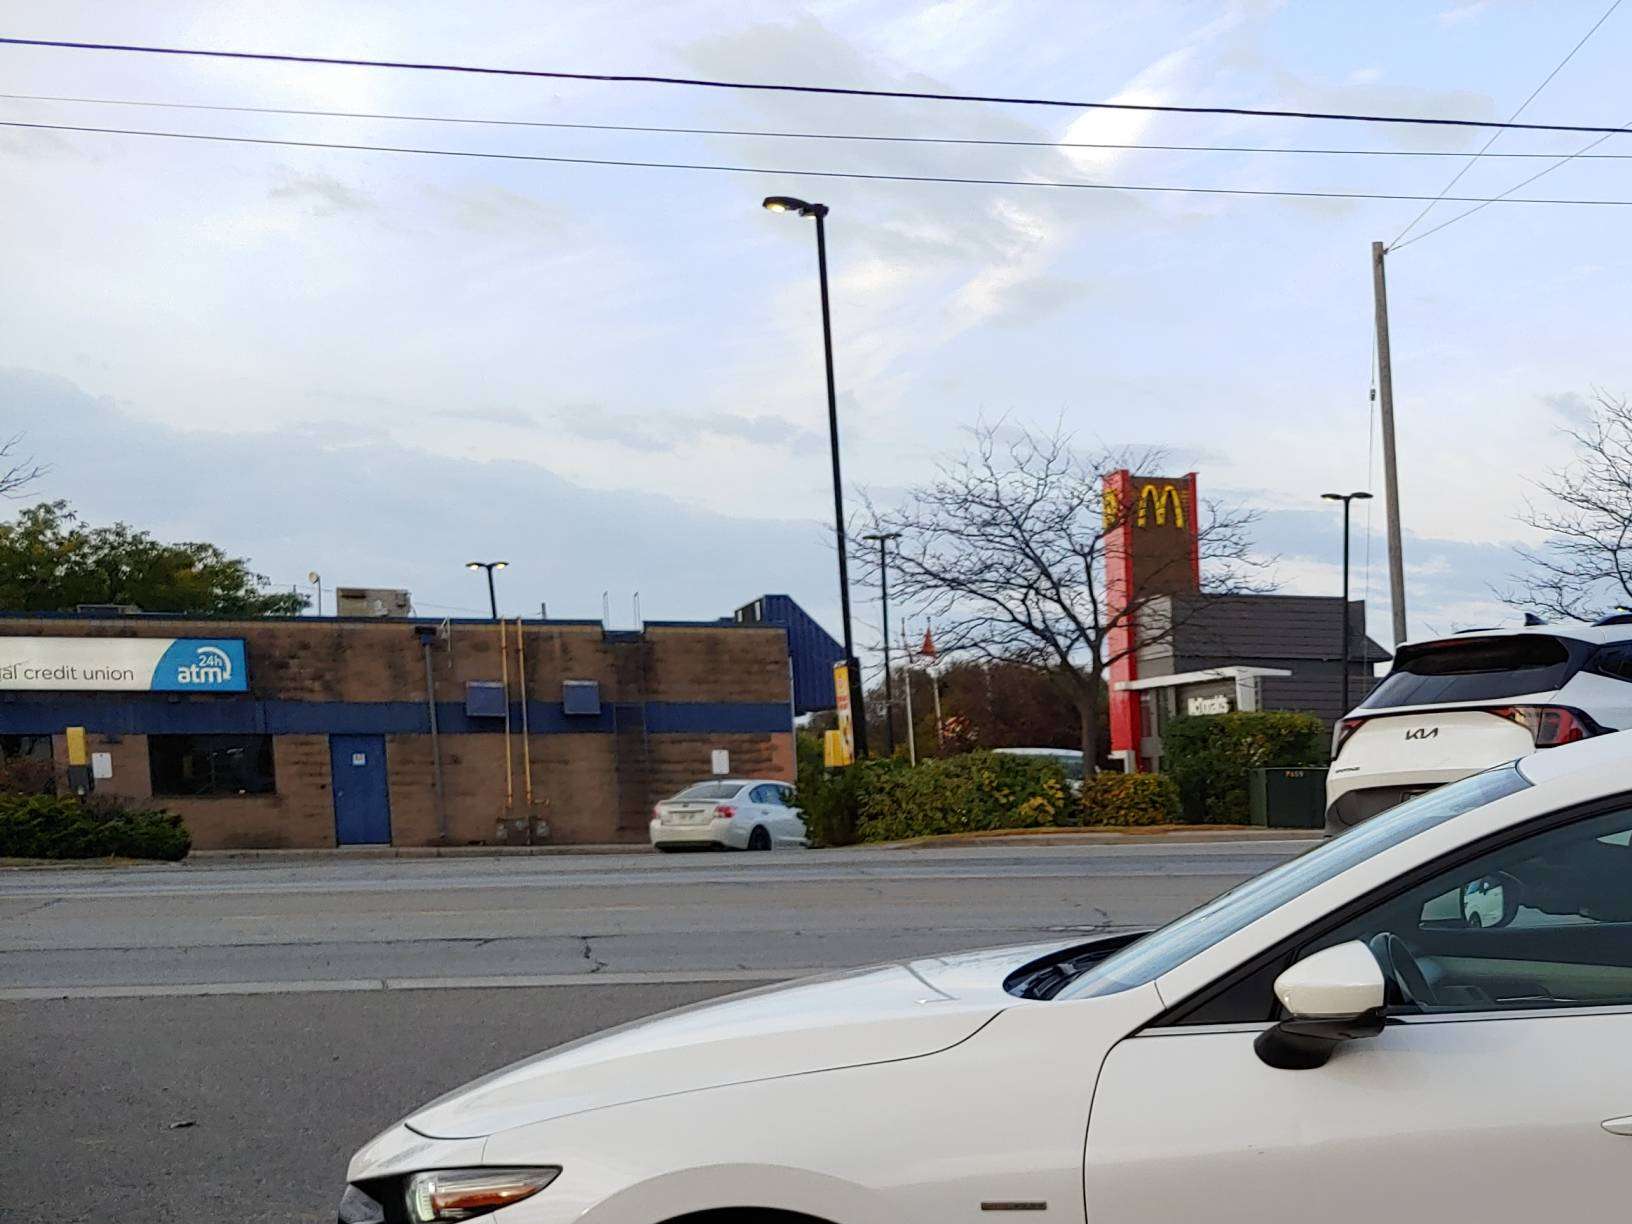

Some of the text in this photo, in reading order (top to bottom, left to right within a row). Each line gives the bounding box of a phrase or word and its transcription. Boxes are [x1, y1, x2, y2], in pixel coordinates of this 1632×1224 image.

[199, 655, 222, 667] 24h
[0, 663, 134, 681] al credit union
[177, 664, 222, 683] atm
[1405, 727, 1439, 740] KIA
